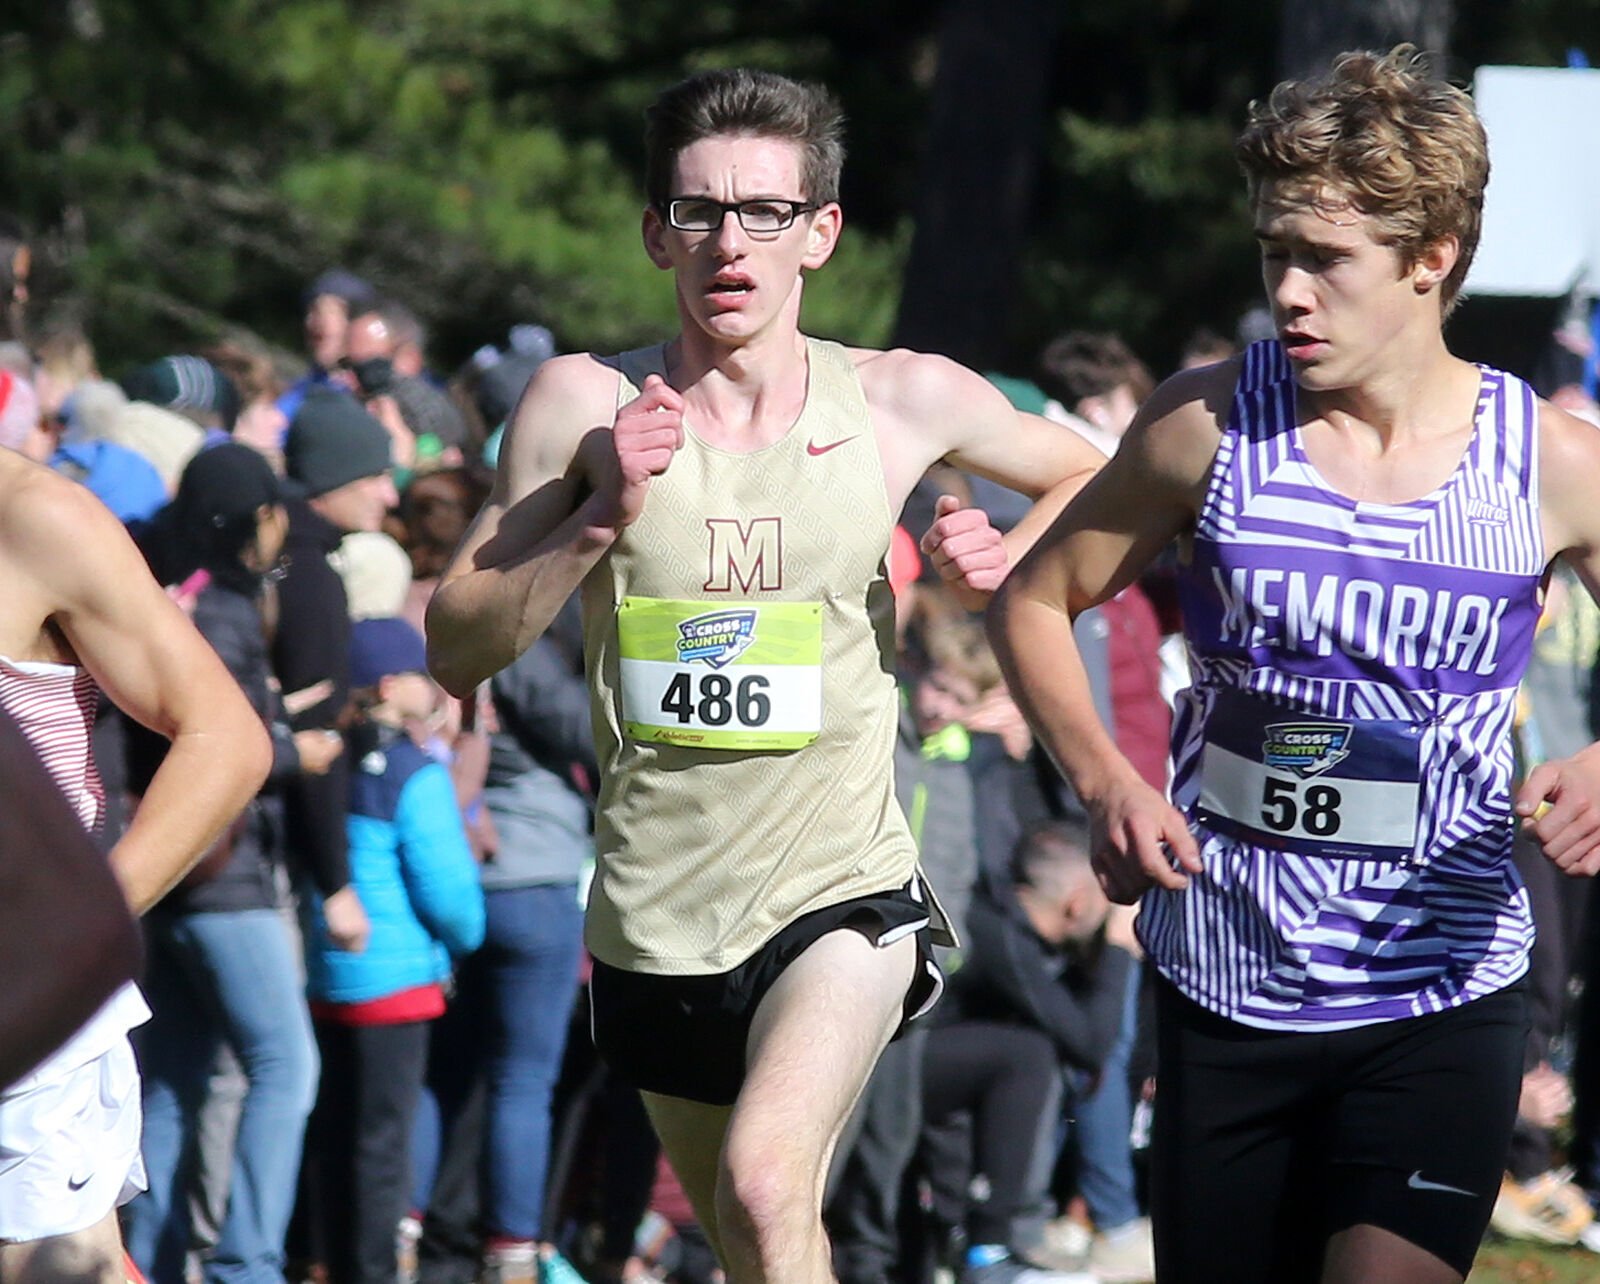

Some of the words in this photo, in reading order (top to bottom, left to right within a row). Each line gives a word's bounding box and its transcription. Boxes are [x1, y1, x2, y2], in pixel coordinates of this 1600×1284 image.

[704, 517, 782, 594] M
[696, 619, 741, 636] CROSS
[1211, 566, 1510, 676] MEMORIAL
[678, 632, 736, 649] COUNTRY
[661, 672, 771, 727] 486
[1266, 744, 1327, 755] COUNTRY
[1284, 733, 1332, 745] CROSS
[1261, 776, 1342, 836] 58
